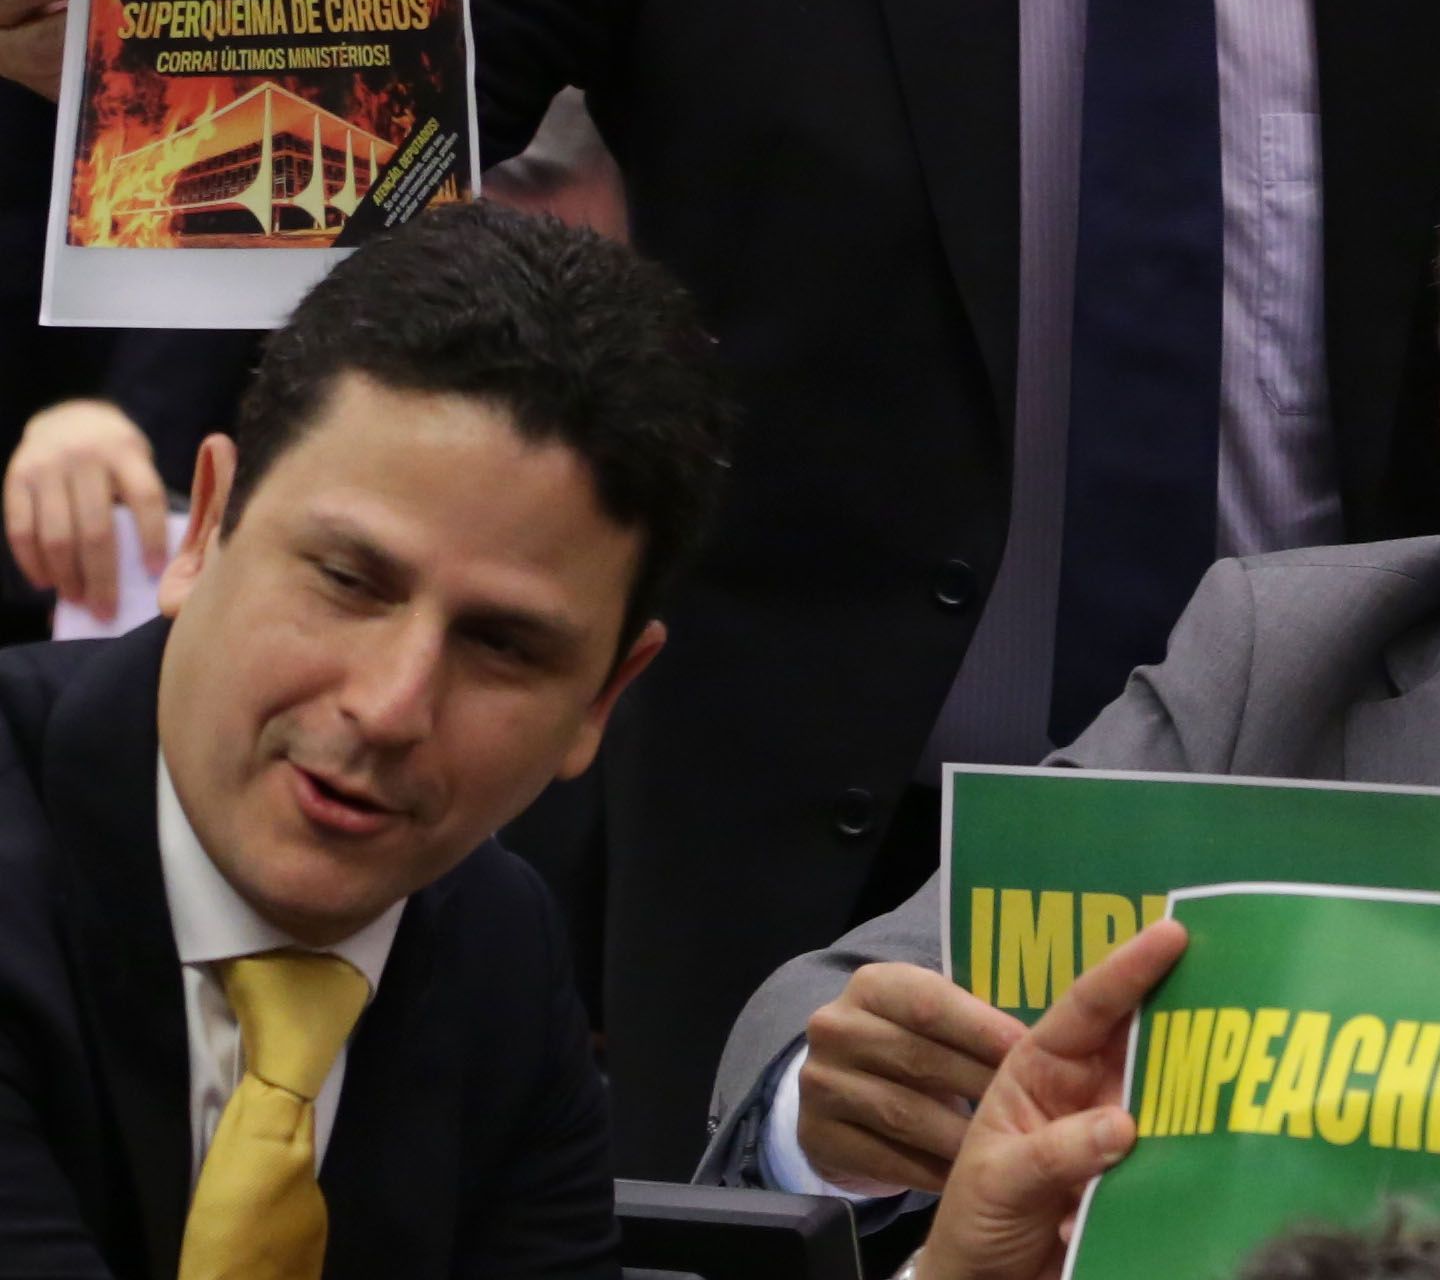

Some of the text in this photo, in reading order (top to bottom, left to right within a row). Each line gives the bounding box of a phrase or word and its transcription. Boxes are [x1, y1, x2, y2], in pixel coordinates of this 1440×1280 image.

[157, 41, 390, 73] CORRA! ÚLTIMOS MINISTÉRIOS!
